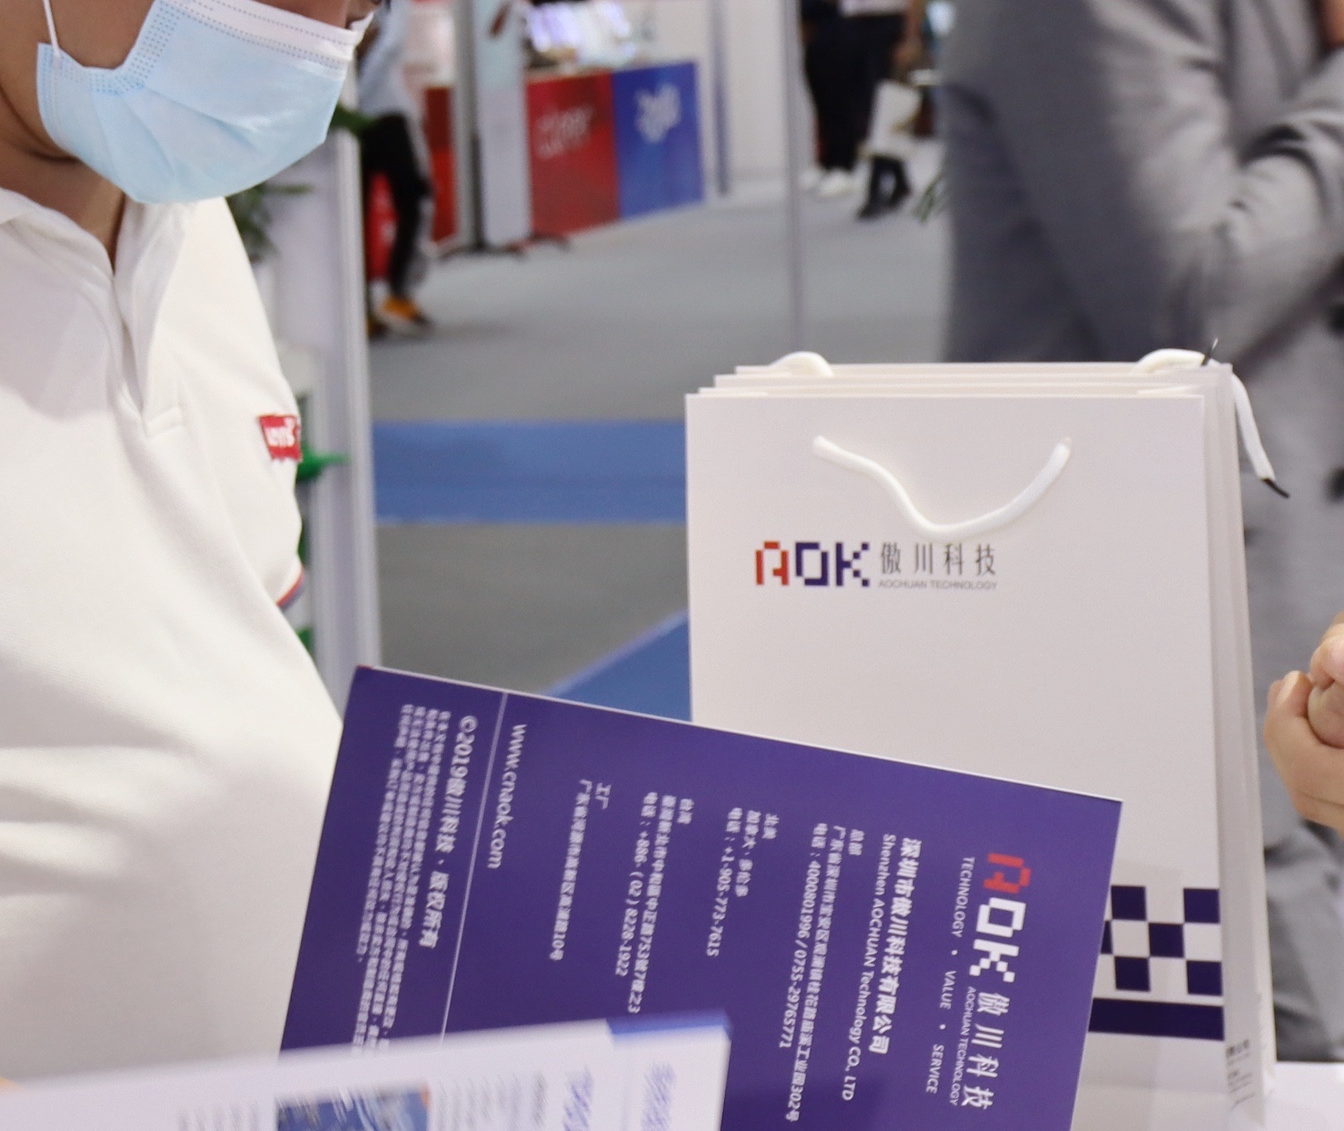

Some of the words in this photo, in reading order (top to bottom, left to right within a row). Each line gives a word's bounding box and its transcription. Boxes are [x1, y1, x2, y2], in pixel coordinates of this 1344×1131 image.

[755, 541, 870, 587] AOK
[878, 578, 928, 589] AOCHUAN
[930, 579, 998, 591] TECHNOLOGY
[880, 541, 997, 576] 傲川科技
[487, 724, 527, 869] www.cnaok.com
[874, 833, 897, 896] Shenzhen
[951, 856, 976, 938] TECHNOLOGY
[863, 897, 886, 968] AOCHUAN
[868, 837, 922, 1055] 深圳市傲川科技有限公司
[968, 852, 1032, 983] AOK
[848, 970, 875, 1044] Technology
[939, 970, 957, 1010] VALUE
[960, 986, 977, 1036] AOCHUAN
[925, 1043, 945, 1094] SERVICE
[949, 1037, 969, 1106] TECHNOLOGY
[961, 991, 1011, 1110] 傲川科技
[841, 1075, 857, 1101] LTD
